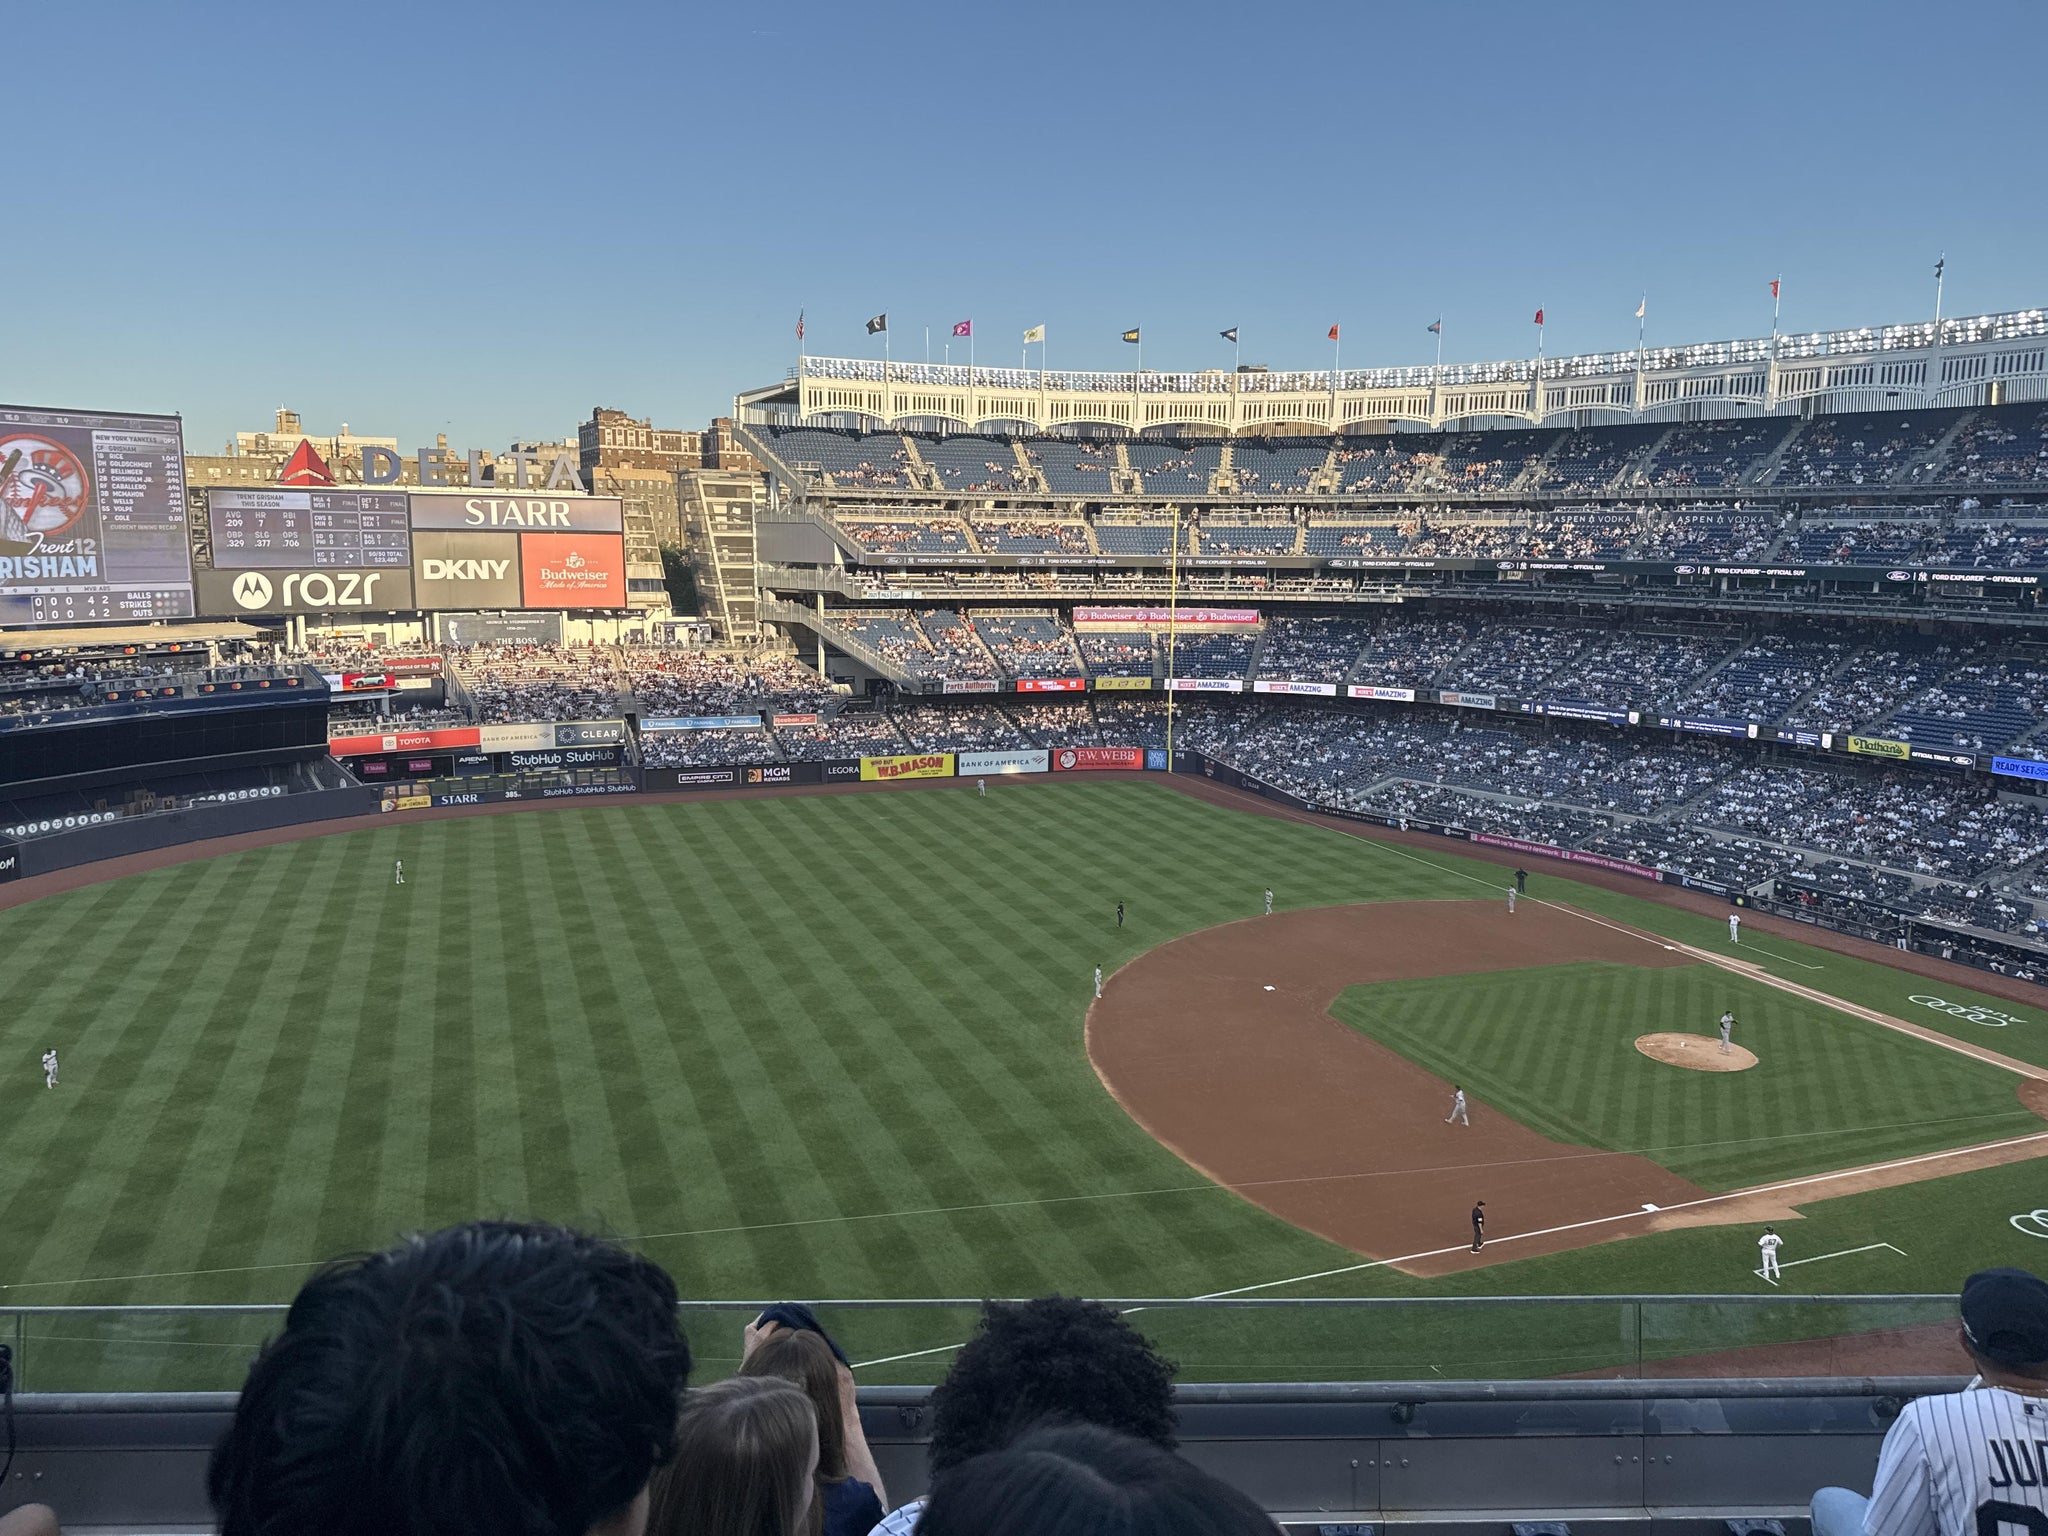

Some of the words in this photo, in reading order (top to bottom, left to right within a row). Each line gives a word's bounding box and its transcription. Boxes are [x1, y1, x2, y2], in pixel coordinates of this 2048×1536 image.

[109, 460, 153, 468] GOLDSCHMIDT
[361, 446, 586, 491] DELTA
[110, 475, 142, 483] CHISHOLM
[112, 490, 145, 498] MCMAHON
[225, 511, 241, 519] AVG
[255, 511, 267, 519] HR
[282, 511, 296, 519] RBI
[465, 498, 571, 528] STARR
[225, 519, 243, 527] .209
[258, 519, 264, 527] 7
[1553, 515, 1586, 523] ASPEN
[1598, 515, 1631, 523] VODKA
[1677, 515, 1713, 524] ASPEN
[1727, 515, 1765, 524] VODKA
[254, 531, 270, 539] SLG
[282, 531, 298, 539] OPS
[25, 531, 75, 556] Trent
[75, 538, 97, 555] 12
[422, 559, 511, 580] DKNY
[540, 568, 609, 580] Budweiser
[1887, 571, 1910, 581] Ford
[576, 580, 607, 589] America
[282, 572, 381, 607] razr
[35, 597, 42, 606] 0
[50, 597, 58, 606] 0
[65, 596, 73, 605] 0
[87, 595, 95, 605] 4
[102, 595, 109, 604] 2
[127, 592, 152, 600] BALLS
[119, 600, 153, 609] STRIKES
[36, 611, 43, 620] 0
[51, 610, 59, 619] 0
[66, 609, 74, 618] 0
[88, 608, 96, 617] 4
[103, 608, 110, 617] 2
[132, 609, 153, 617] OUTS
[1090, 612, 1133, 621] Budweiser
[1210, 612, 1253, 621] Budweiser
[495, 637, 513, 645] THE
[515, 637, 538, 645] BOSS
[945, 682, 963, 690] Parts
[964, 682, 997, 690] Authority
[1197, 681, 1230, 689] AMAZING
[1289, 684, 1322, 693] AMAZING
[1374, 690, 1407, 698] AMAZING
[1460, 695, 1493, 706] AMAZING
[581, 729, 618, 739] CLEAR
[399, 736, 431, 746] TOYOTA
[1853, 738, 1904, 754] Nathan's
[459, 755, 488, 763] ARENA
[511, 753, 562, 766] StubHub
[566, 750, 614, 762] StubHub
[1078, 750, 1098, 761] F.W.
[1101, 750, 1136, 761] WEBB
[1911, 751, 1934, 760] OFFICIAL
[883, 758, 894, 766] BUT
[763, 767, 791, 777] MGM
[828, 766, 860, 775] LEGORA
[1995, 761, 2020, 772] READY
[2020, 764, 2035, 775] SET
[543, 788, 573, 797] StubHub
[575, 786, 605, 794] StubHub
[607, 784, 636, 792] StubHub
[441, 793, 478, 805] STARR
[1970, 1006, 2028, 1022] Audi
